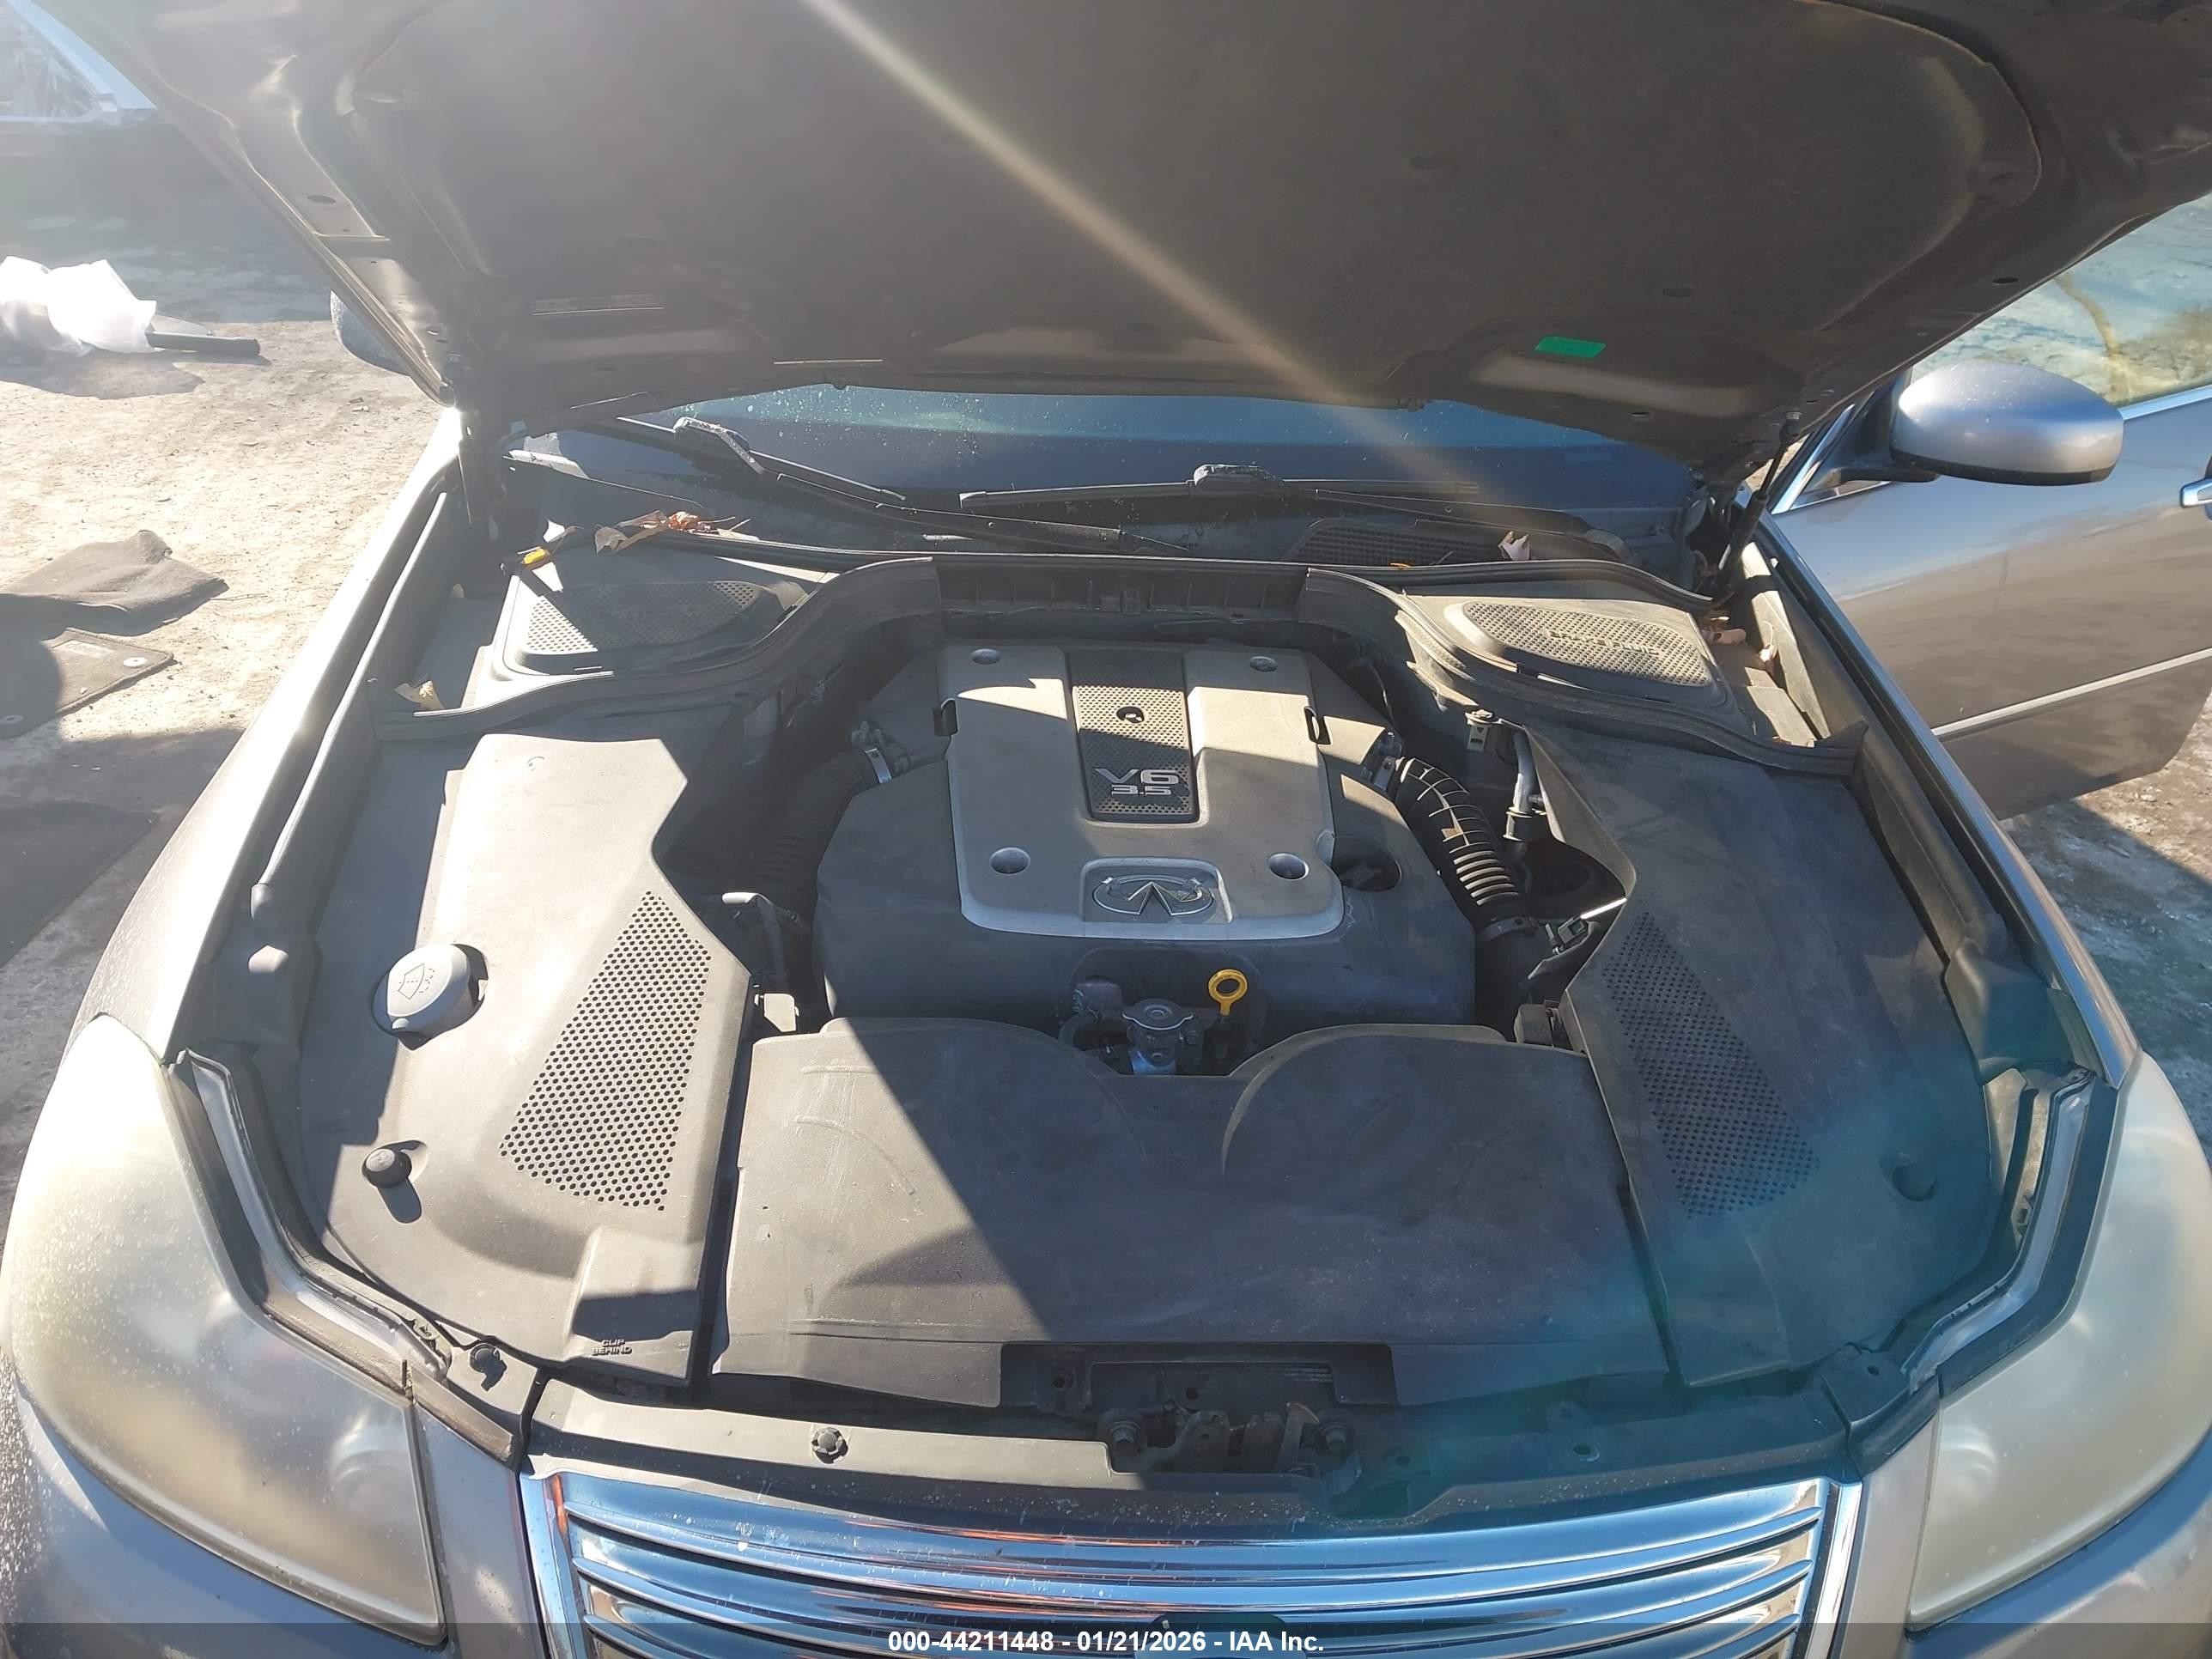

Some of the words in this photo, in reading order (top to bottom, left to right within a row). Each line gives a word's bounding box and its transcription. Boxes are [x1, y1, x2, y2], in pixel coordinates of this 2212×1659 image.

[1095, 769, 1179, 785] V6
[1111, 784, 1172, 797] 3.5
[592, 1346, 633, 1356] BEHIND
